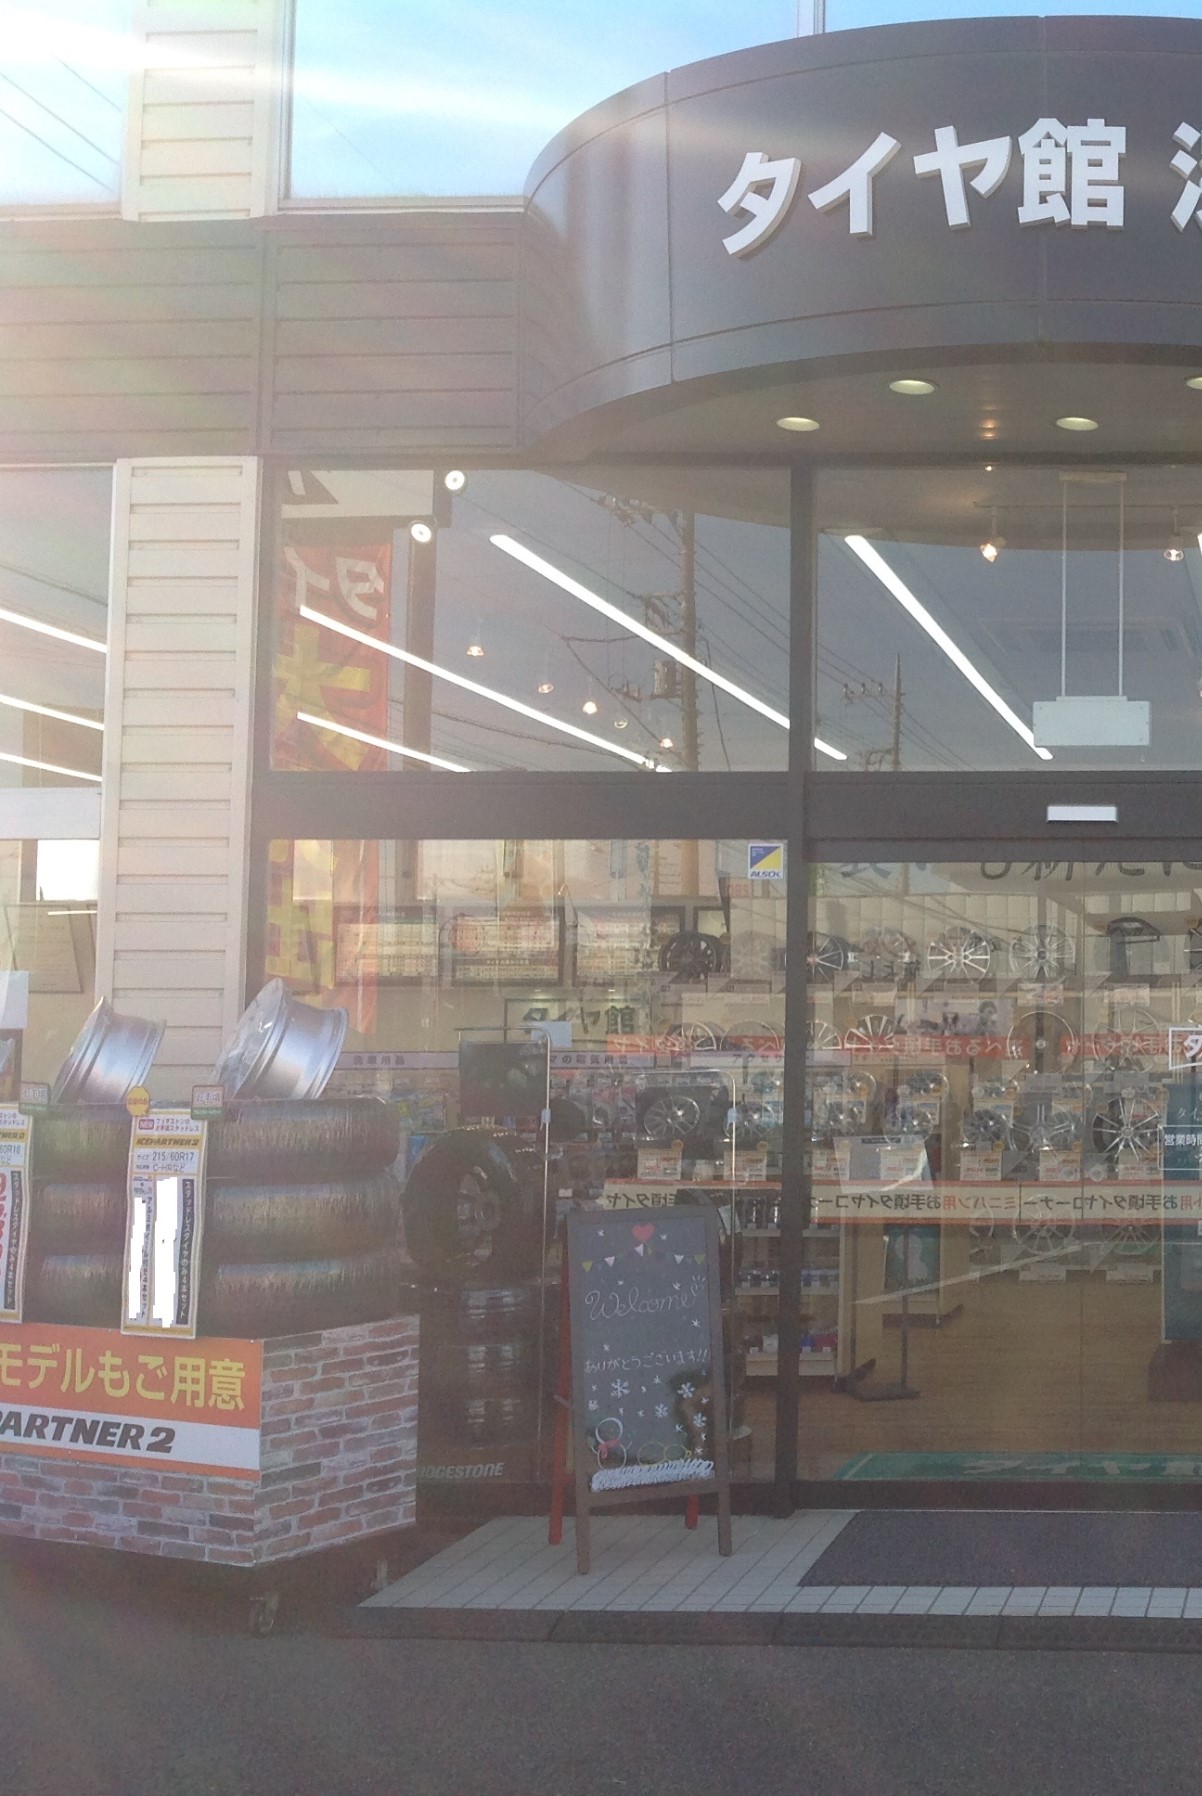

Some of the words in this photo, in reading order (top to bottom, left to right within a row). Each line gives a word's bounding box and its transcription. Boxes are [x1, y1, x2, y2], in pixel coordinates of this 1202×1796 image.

[717, 117, 1127, 258] タイヤ館
[750, 871, 782, 879] ALSOK
